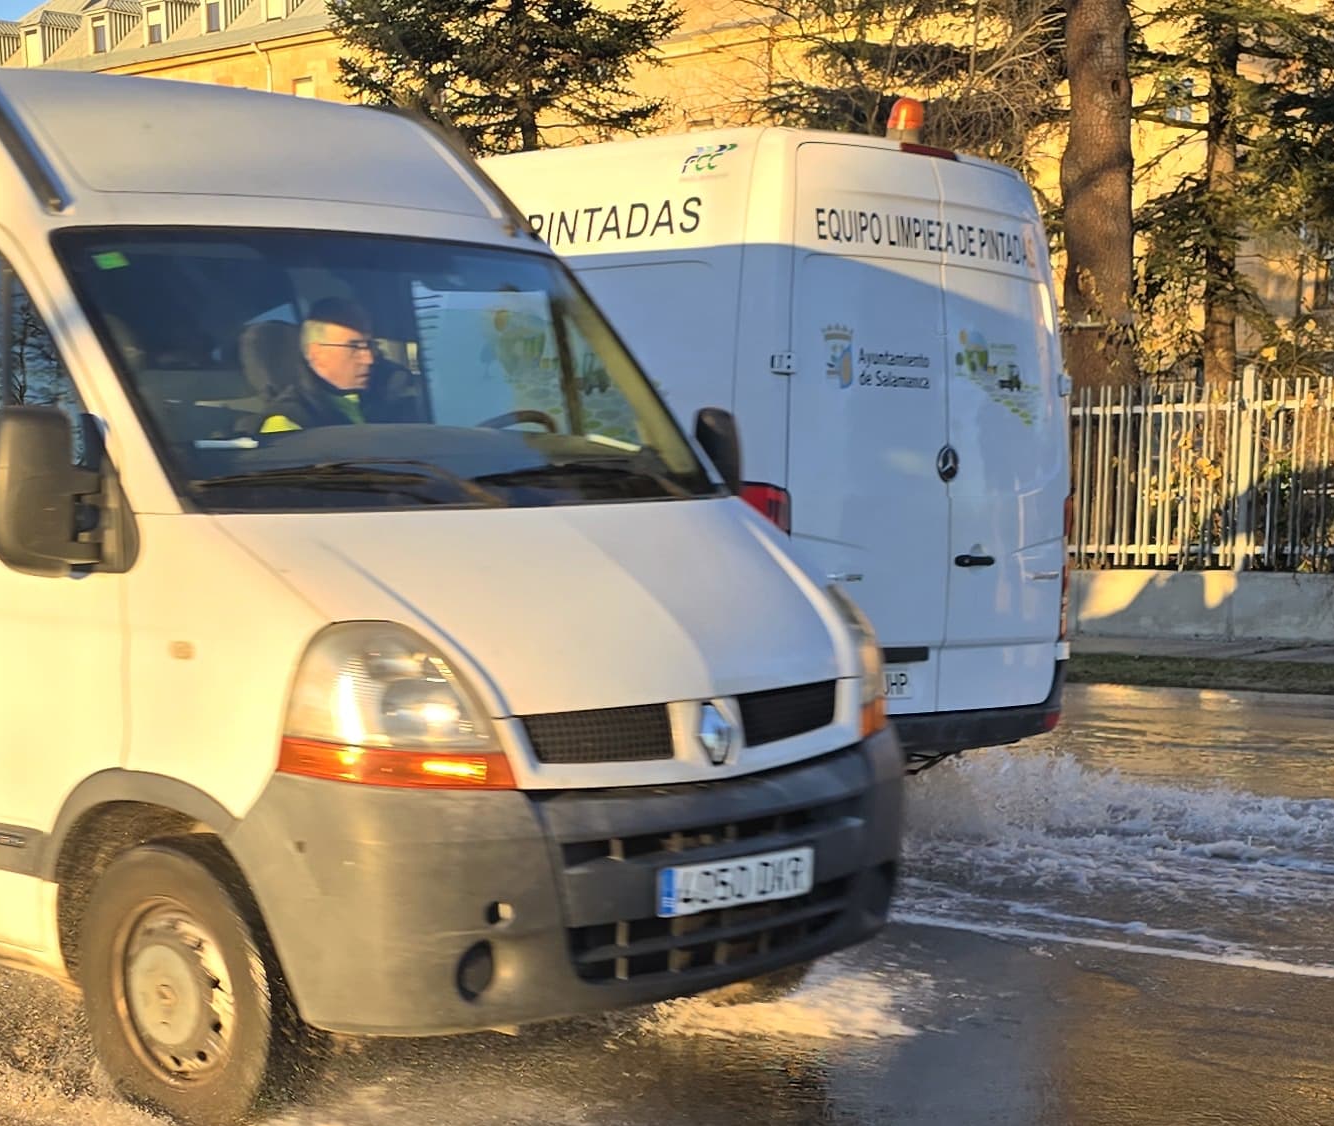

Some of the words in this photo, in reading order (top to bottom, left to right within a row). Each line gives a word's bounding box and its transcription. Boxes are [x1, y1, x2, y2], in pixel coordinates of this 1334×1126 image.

[528, 196, 702, 248] PINTADAS
[816, 207, 882, 245] EQUIPO
[886, 214, 956, 255] LIMPIEZA
[957, 224, 977, 257] DE
[978, 228, 1036, 269] PINTADAS
[858, 347, 930, 369] Ayuntamiento
[859, 369, 872, 386] de
[874, 370, 930, 390] Salamanca
